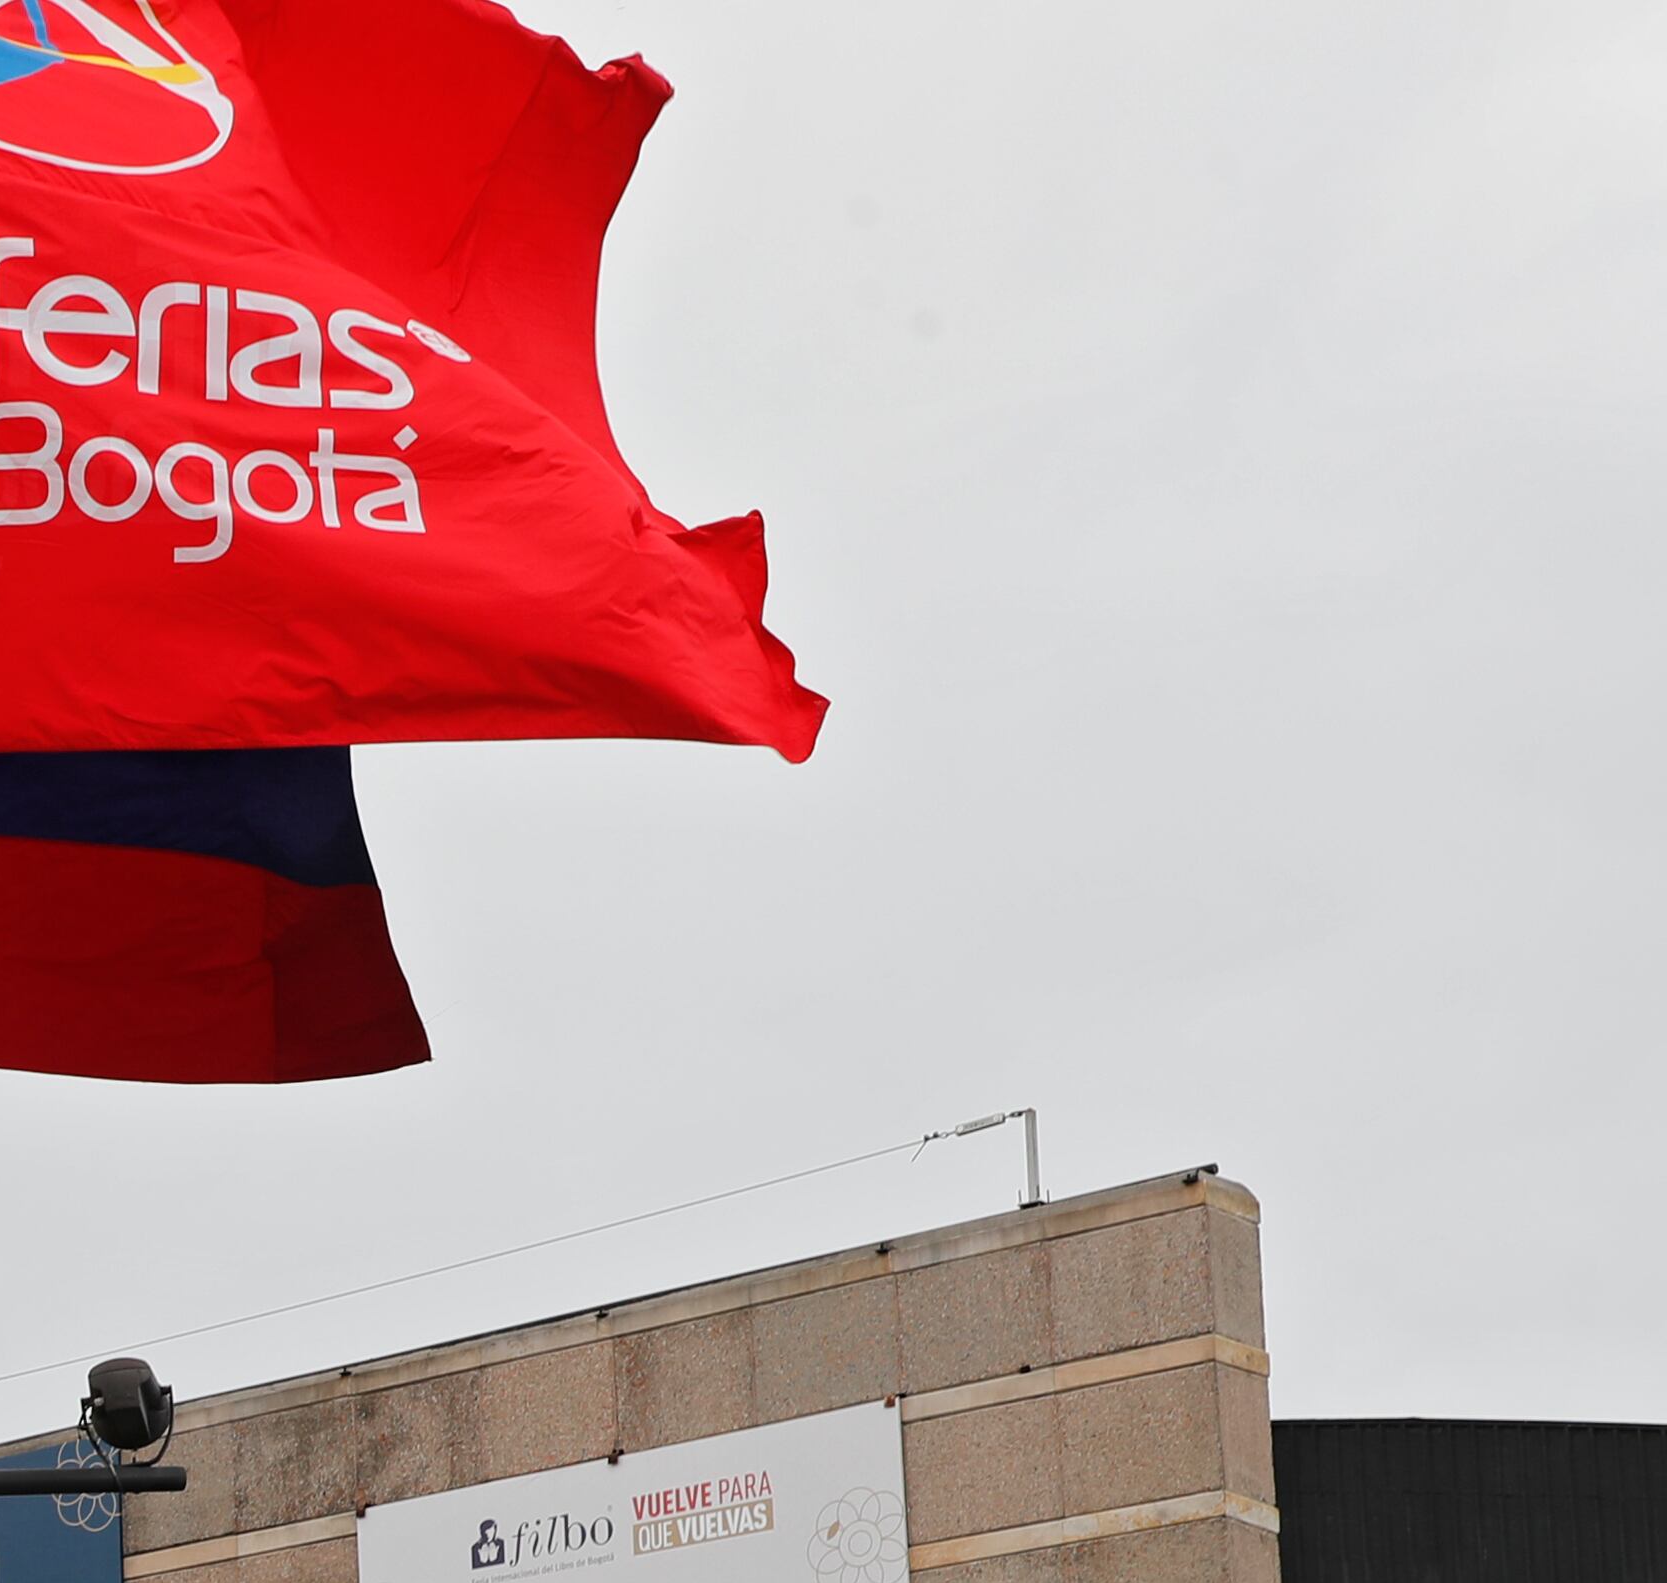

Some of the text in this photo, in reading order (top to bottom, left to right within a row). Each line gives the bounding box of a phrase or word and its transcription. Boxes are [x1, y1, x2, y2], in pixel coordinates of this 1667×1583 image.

[632, 1470, 772, 1521] VUELVE PARA
[509, 1513, 614, 1568] filbo
[638, 1502, 767, 1553] QUE VUELVAS
[490, 1566, 540, 1583] Internacional
[541, 1565, 554, 1575] del
[555, 1561, 575, 1573] Libro
[576, 1557, 586, 1567] de
[587, 1552, 615, 1567] Bogotá
